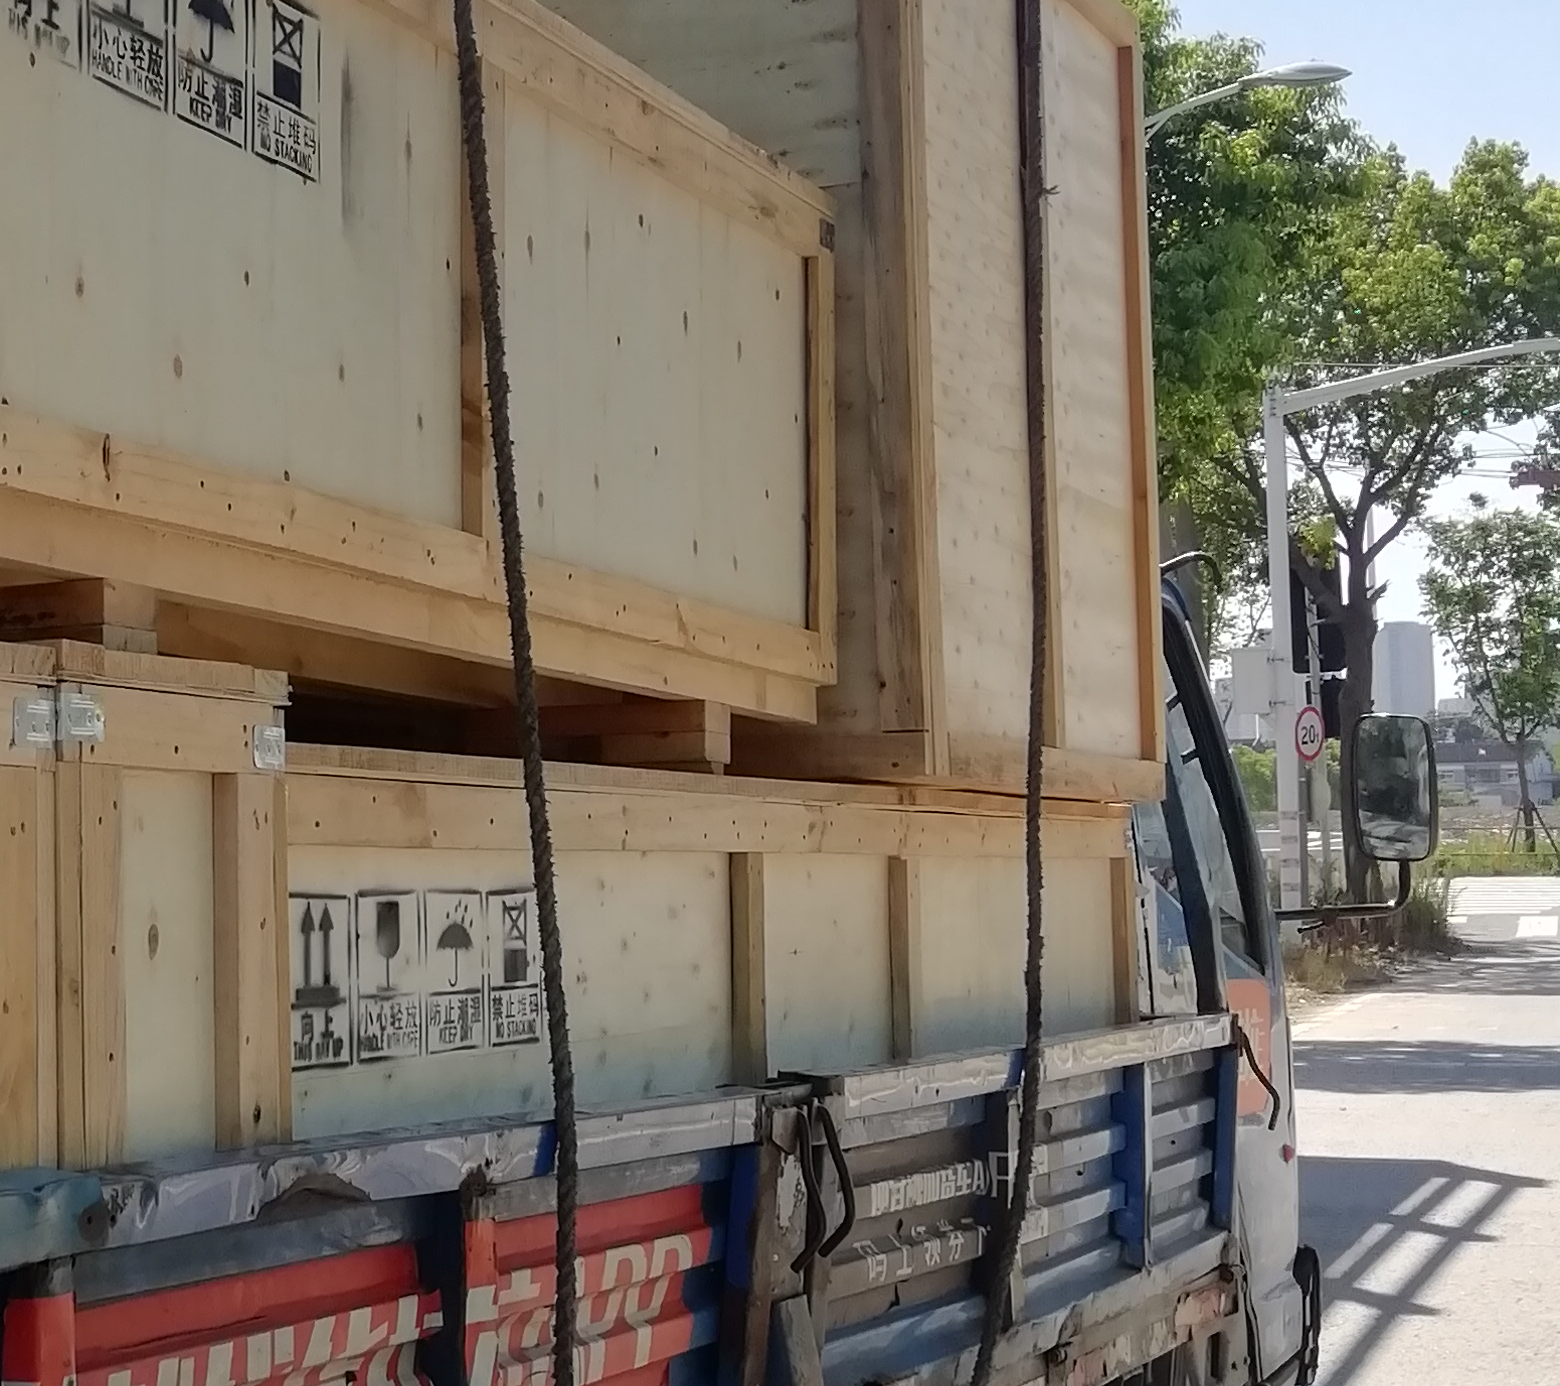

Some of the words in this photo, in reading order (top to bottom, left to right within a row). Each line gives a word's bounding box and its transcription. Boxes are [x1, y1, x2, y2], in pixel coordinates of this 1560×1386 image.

[93, 21, 163, 81] 小心轻放
[178, 60, 243, 120] 防止潮湿
[190, 96, 212, 123] KEEP
[257, 100, 316, 155] 禁止堆码
[274, 138, 313, 173] STACKING
[360, 1000, 418, 1034] 小心轻放
[430, 996, 481, 1028] 防止潮湿
[492, 993, 539, 1021] 禁止堆码
[301, 1008, 335, 1043] 向上
